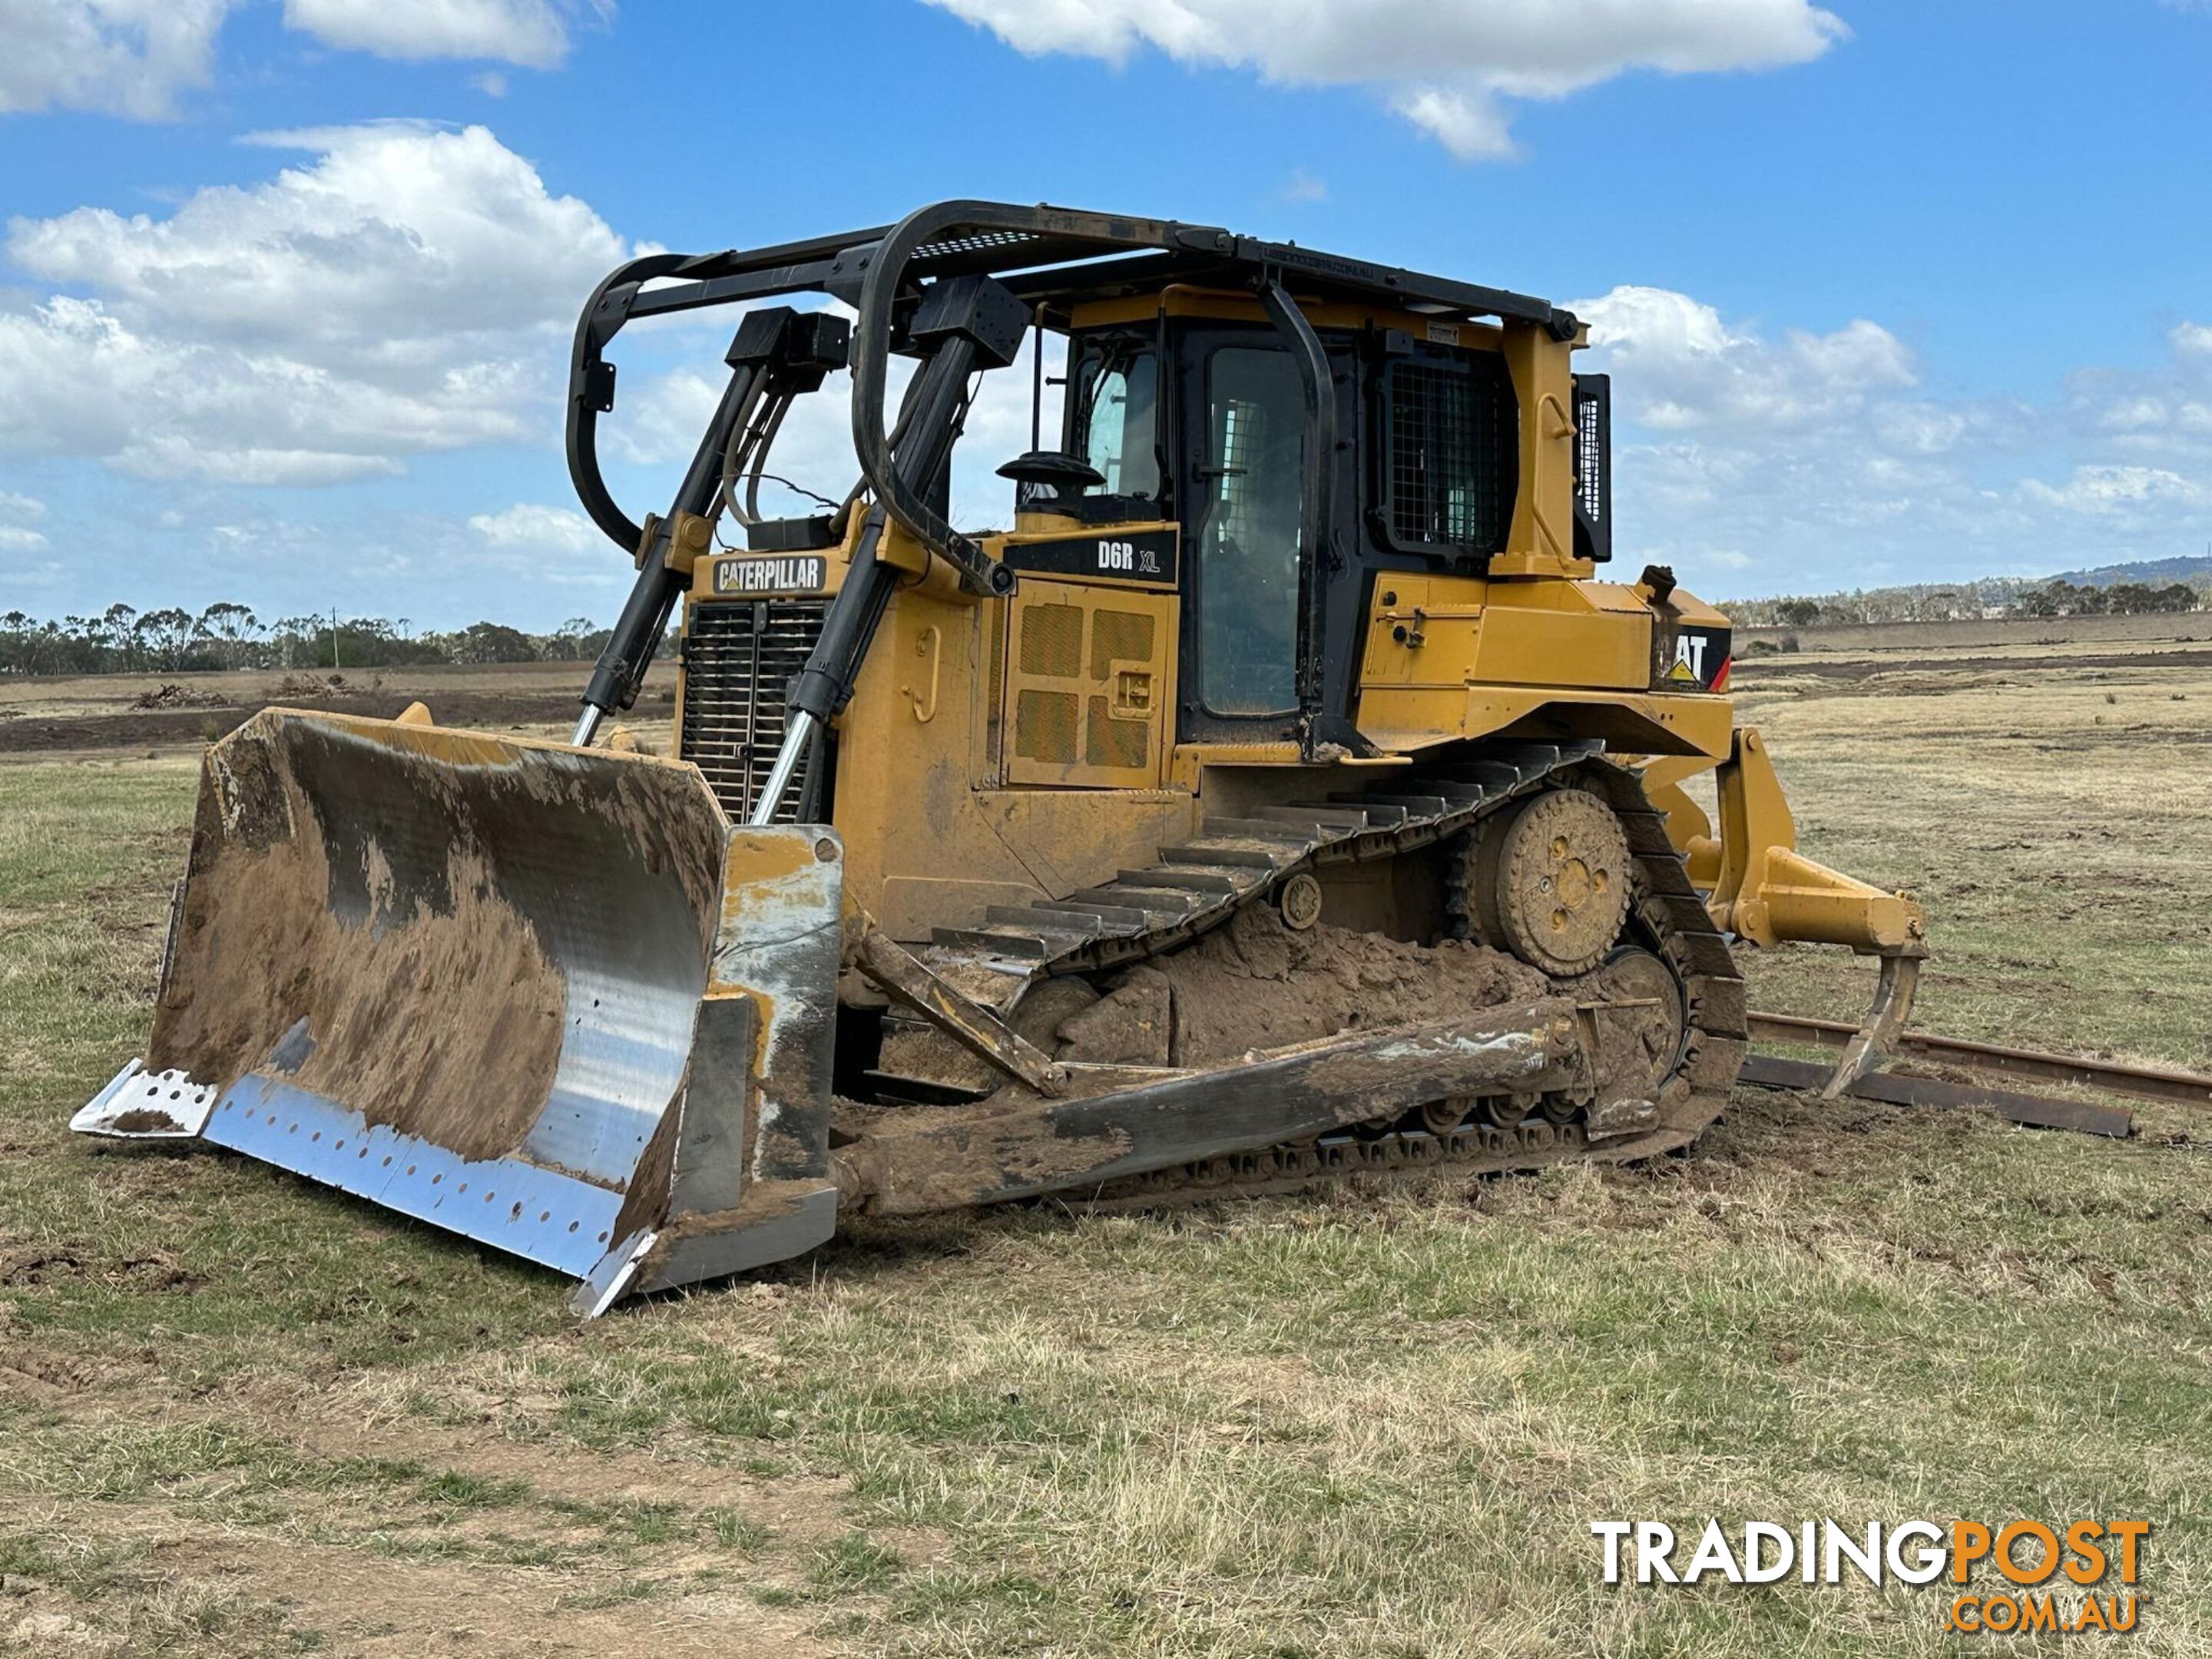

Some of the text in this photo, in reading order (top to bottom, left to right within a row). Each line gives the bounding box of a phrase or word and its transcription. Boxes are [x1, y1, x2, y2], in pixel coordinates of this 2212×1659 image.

[1098, 541, 1160, 573] D6R XL
[719, 559, 819, 591] CATERPILLAR
[1660, 634, 1707, 681] AT
